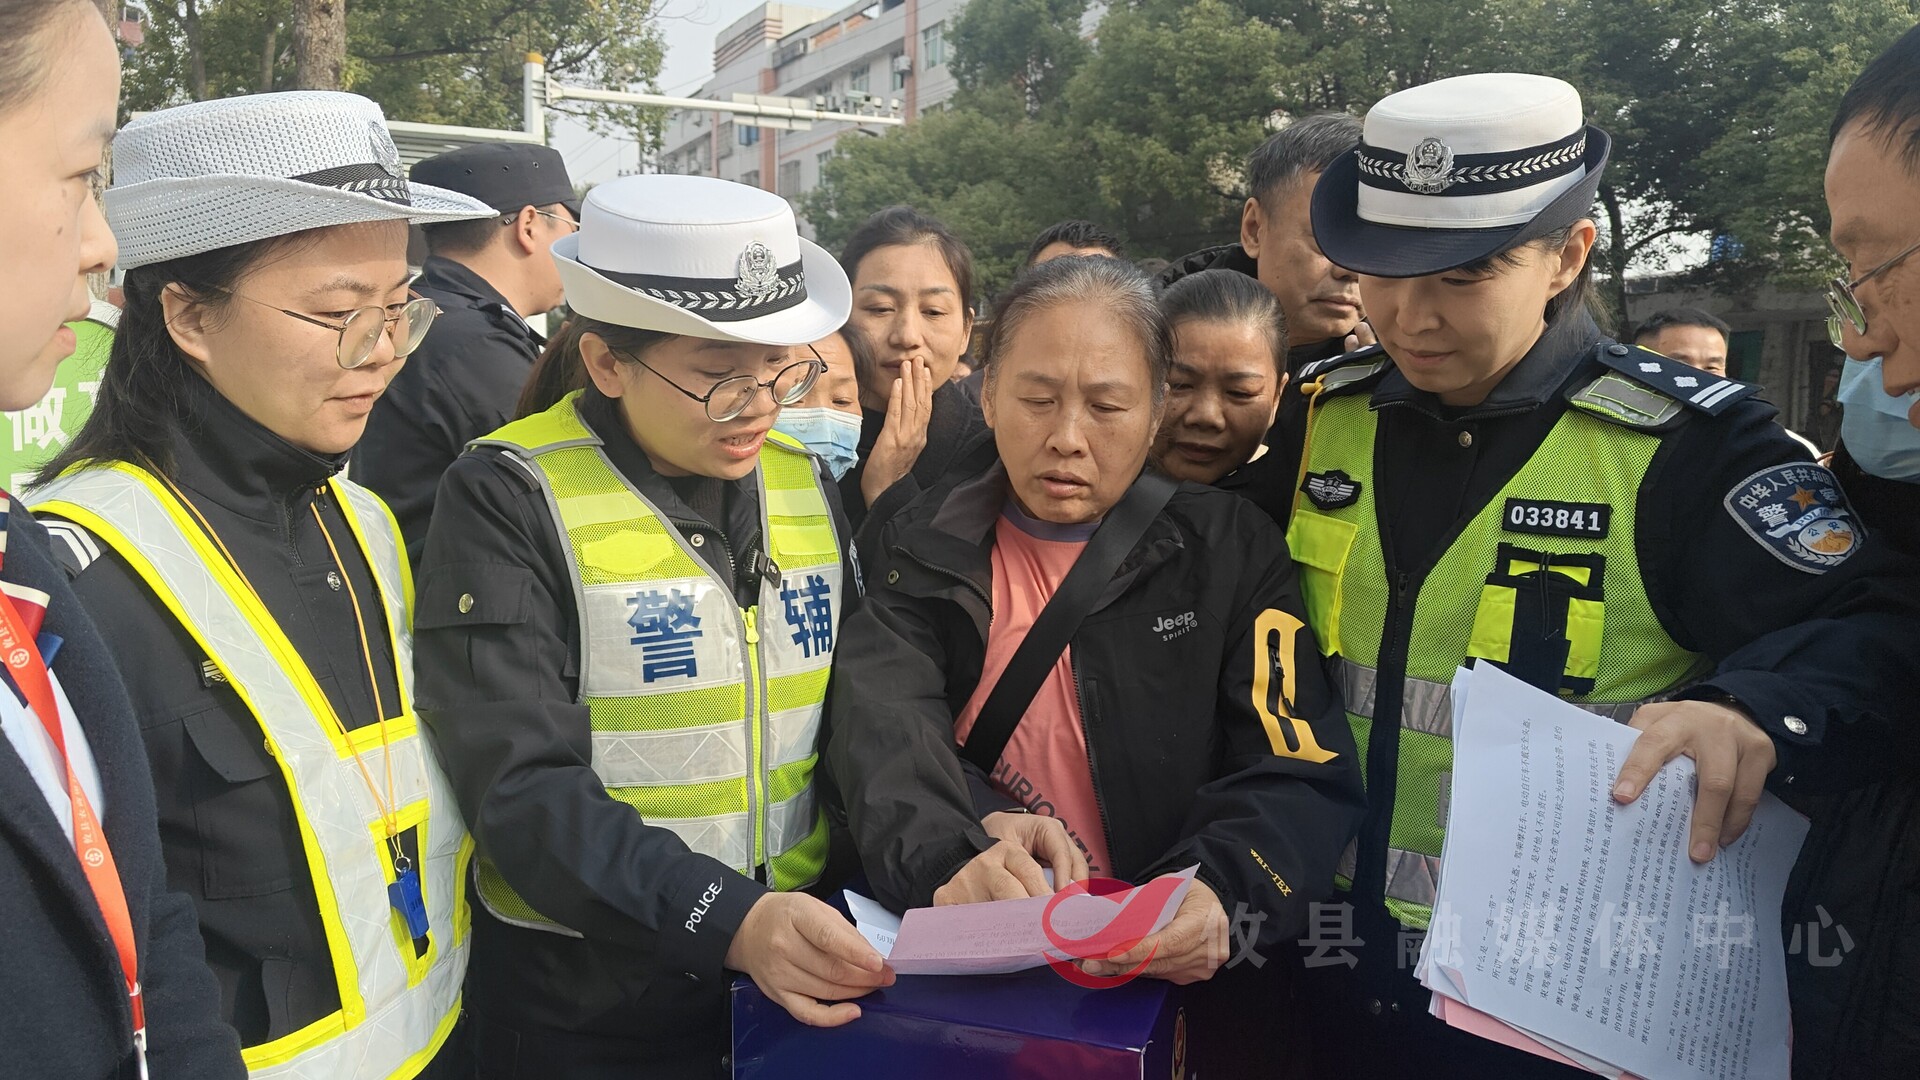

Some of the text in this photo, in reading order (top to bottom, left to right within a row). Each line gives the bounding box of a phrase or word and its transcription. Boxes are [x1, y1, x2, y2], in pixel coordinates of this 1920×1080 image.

[4, 382, 102, 452] 做
[1511, 506, 1601, 531] 033841
[626, 574, 833, 683] 警 辅
[1152, 611, 1195, 632] Jeep
[1162, 625, 1190, 641] SPIRIT
[685, 878, 723, 933] POLICE
